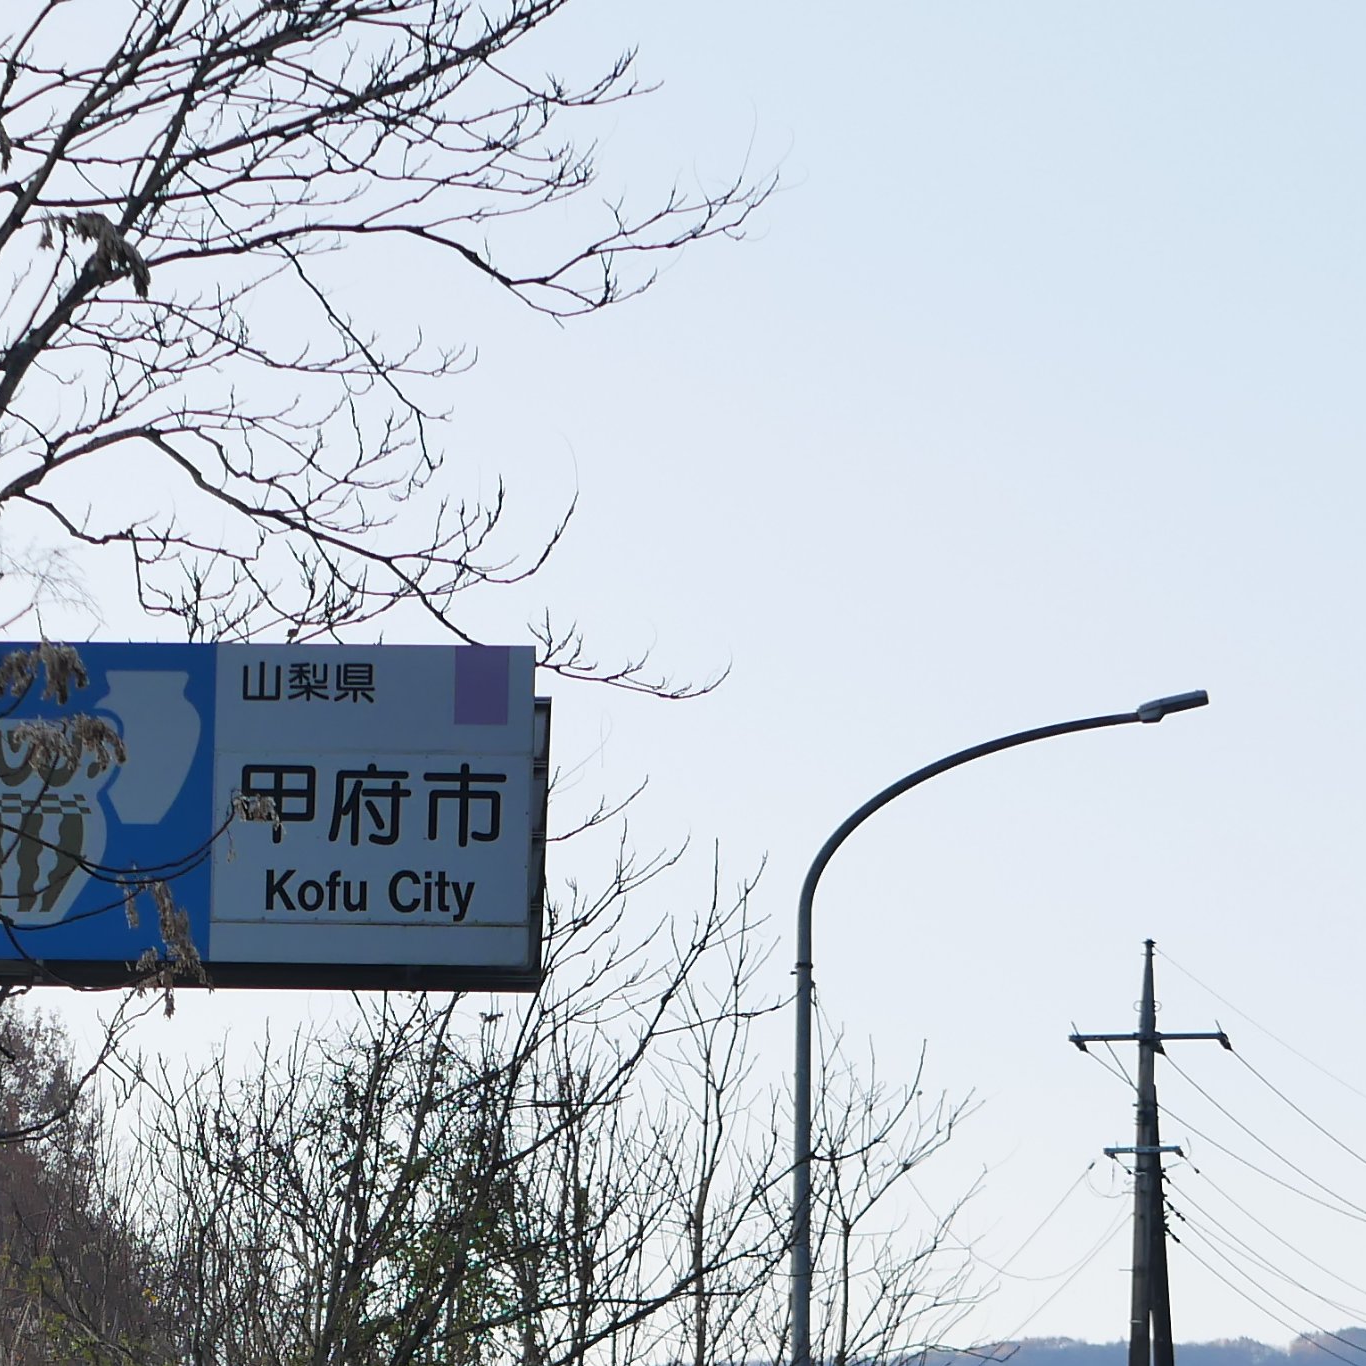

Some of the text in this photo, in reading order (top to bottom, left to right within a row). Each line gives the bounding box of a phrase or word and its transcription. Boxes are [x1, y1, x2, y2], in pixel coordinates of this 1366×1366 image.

[242, 662, 376, 703] 山梨県
[240, 763, 507, 847] 甲府市
[264, 869, 476, 923] Kofu City
